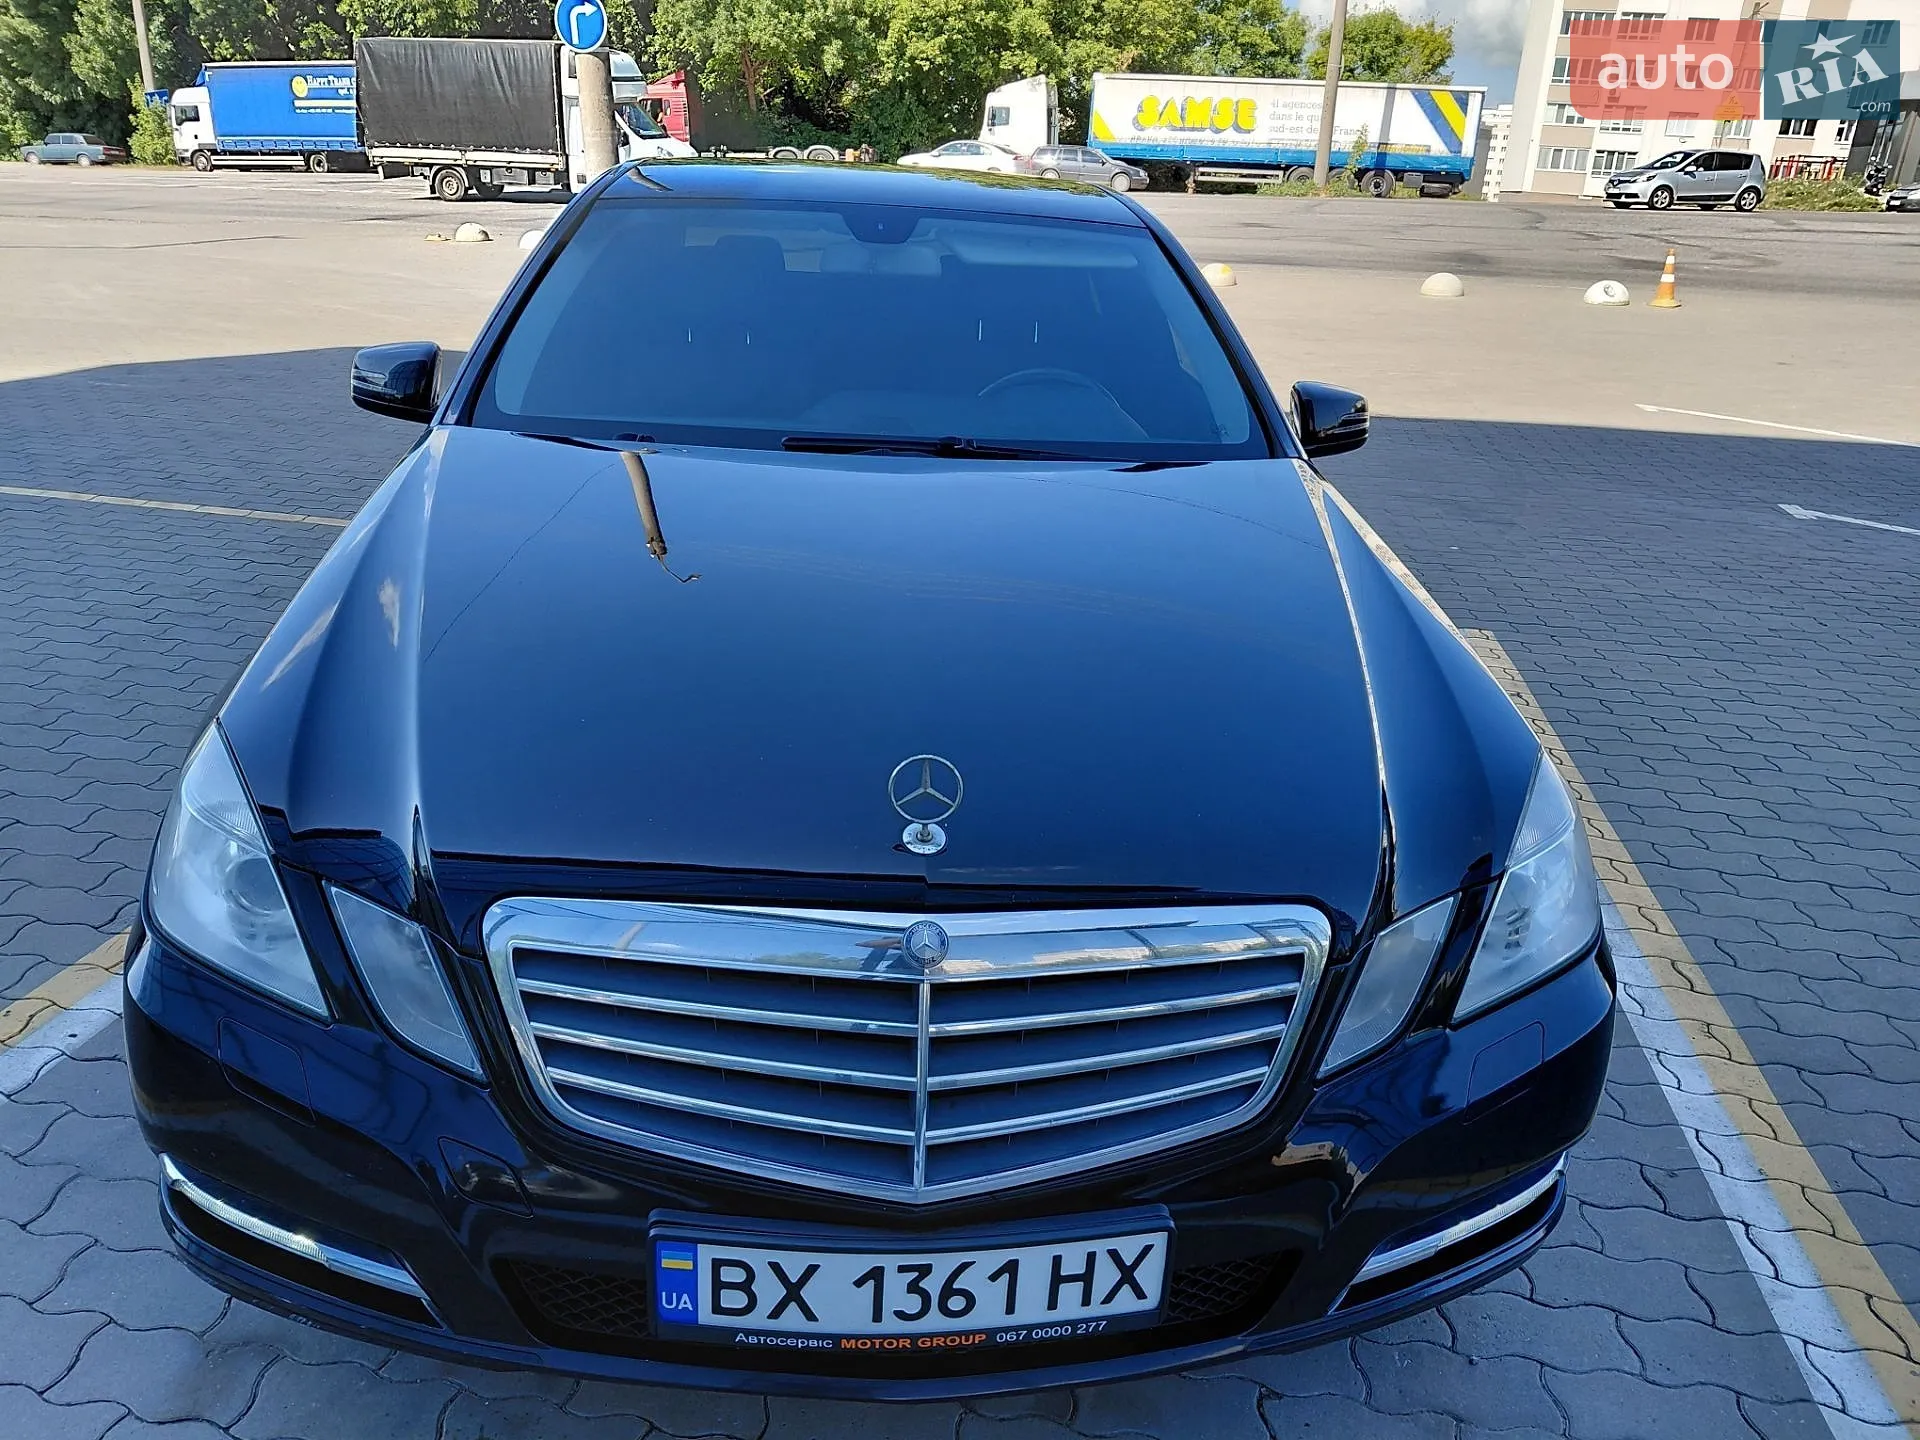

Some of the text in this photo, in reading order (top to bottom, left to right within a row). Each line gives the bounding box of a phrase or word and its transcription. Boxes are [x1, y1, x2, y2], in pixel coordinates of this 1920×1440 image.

[1134, 95, 1257, 133] SAMSE
[1269, 111, 1293, 121] dans
[1268, 123, 1304, 134] sud-est
[710, 1243, 1155, 1324] BX 1361 HX
[662, 1291, 694, 1311] UA
[734, 1320, 1108, 1350] Автосервіс MOTOR GROUP 067 0000 277
